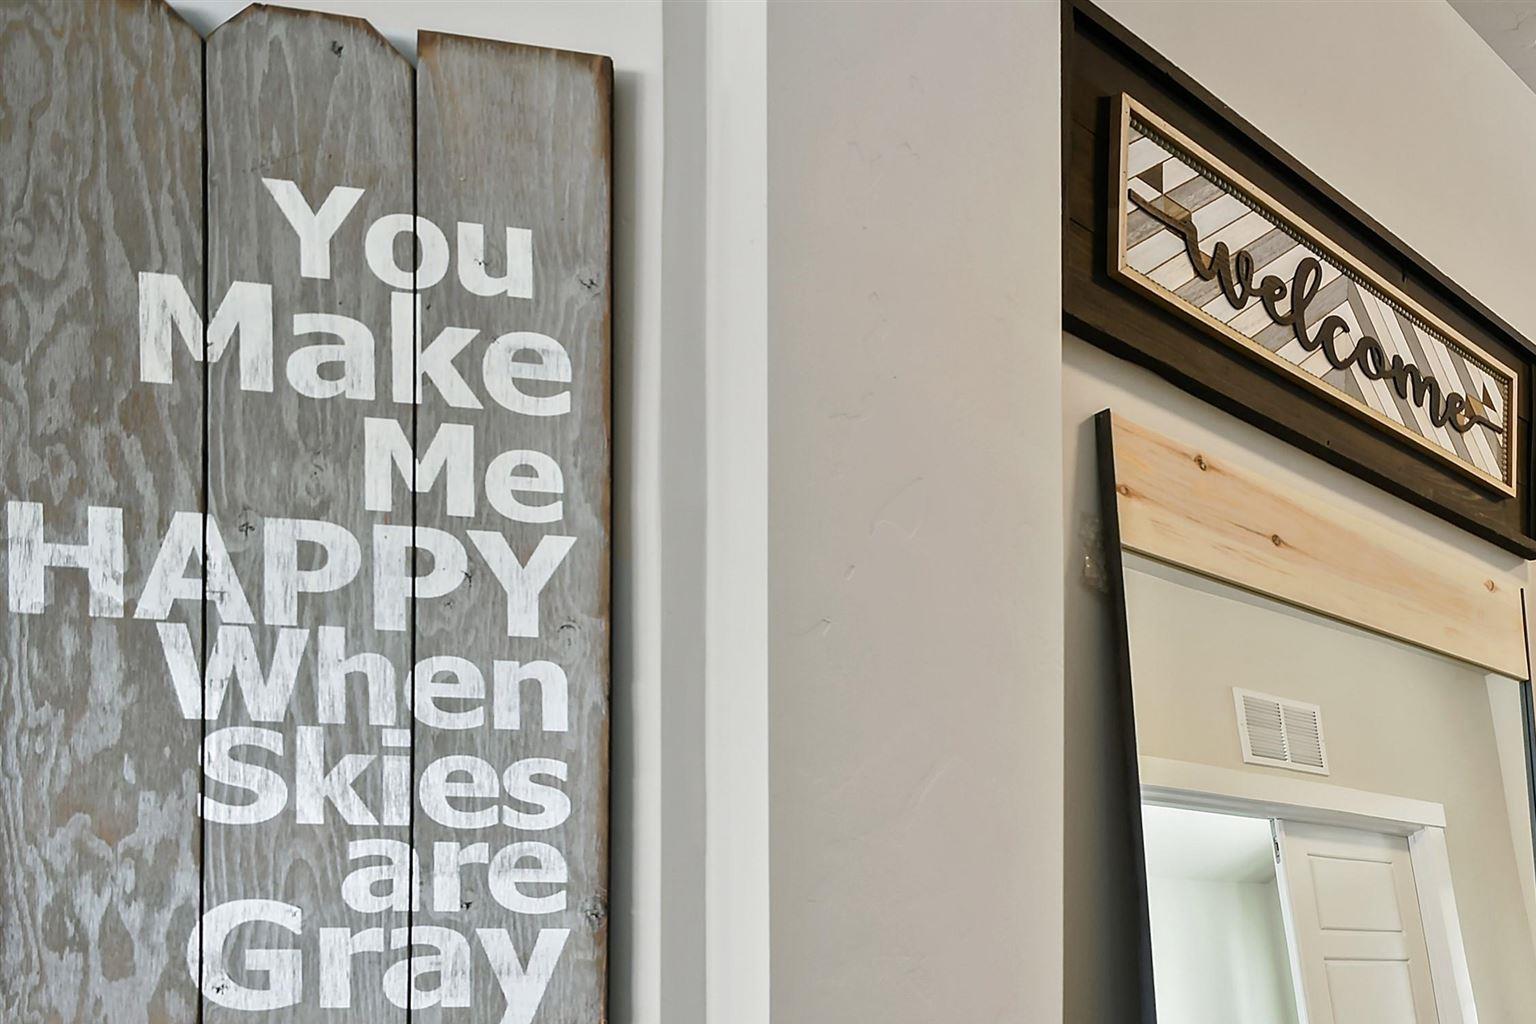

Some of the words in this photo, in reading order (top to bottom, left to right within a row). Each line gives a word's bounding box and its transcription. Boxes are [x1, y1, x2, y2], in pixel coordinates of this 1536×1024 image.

[261, 177, 533, 299] You
[138, 271, 573, 417] Make
[1180, 215, 1484, 434] welcome
[364, 417, 564, 523] Me
[7, 500, 578, 638] HAPPY
[155, 622, 569, 732] When
[197, 726, 572, 831] Skies
[341, 837, 568, 914] are
